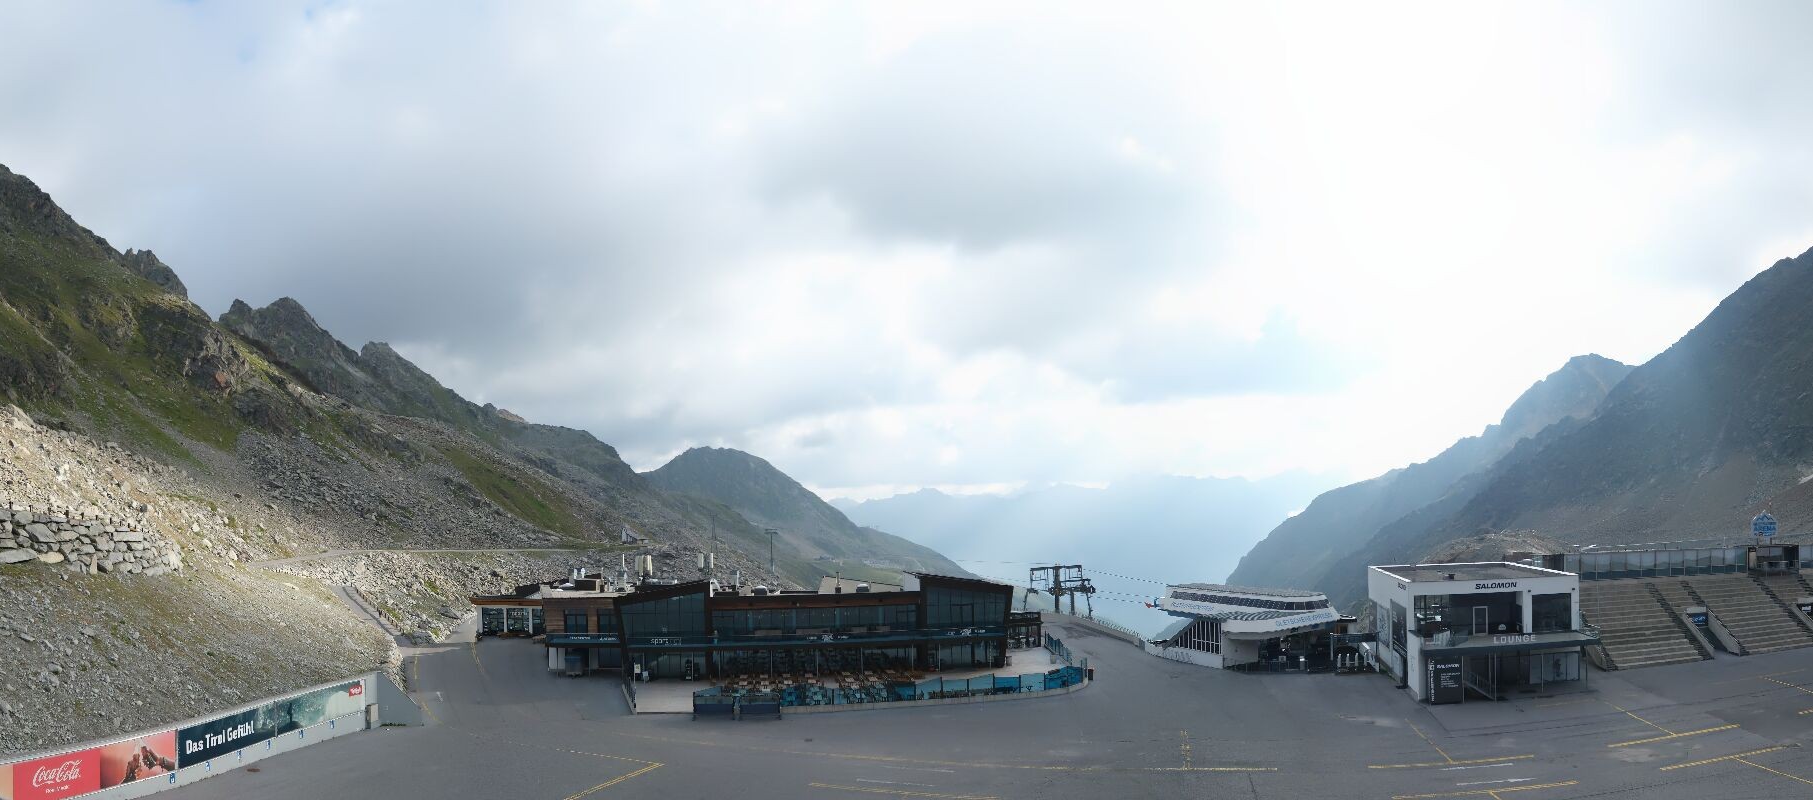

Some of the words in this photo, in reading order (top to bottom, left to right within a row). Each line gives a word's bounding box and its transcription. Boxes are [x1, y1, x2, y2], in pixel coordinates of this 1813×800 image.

[1475, 582, 1517, 590] SALOMON
[1493, 634, 1537, 644] LOUNGE
[186, 740, 204, 755] Das
[205, 729, 226, 749] Tirol
[227, 720, 255, 742] Gefühl
[32, 759, 83, 788] Coca-Cola
